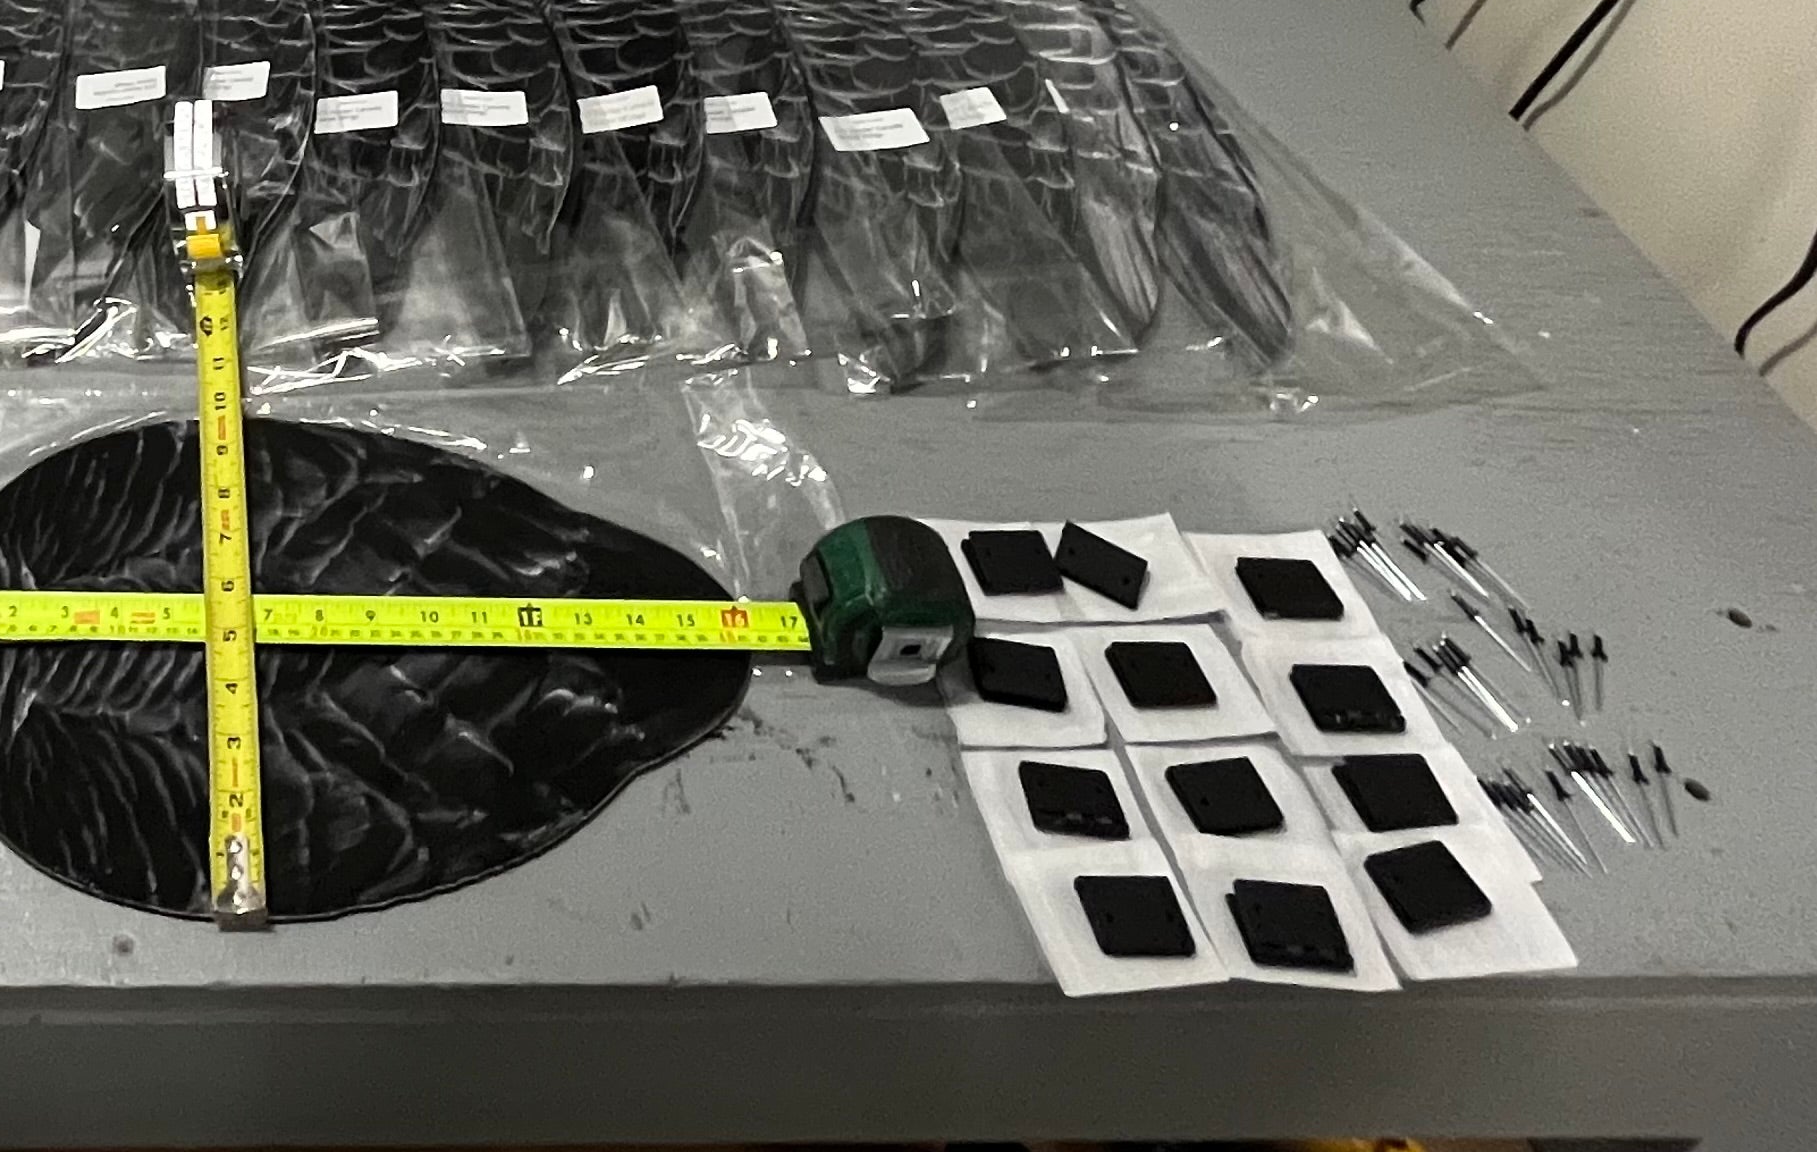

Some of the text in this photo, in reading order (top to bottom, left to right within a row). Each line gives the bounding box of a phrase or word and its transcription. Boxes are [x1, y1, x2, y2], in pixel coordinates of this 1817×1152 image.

[214, 392, 226, 410] 10
[216, 445, 229, 455] 9
[218, 489, 231, 499] 8
[219, 532, 232, 545] 7
[221, 580, 234, 592] 6
[9, 605, 18, 617] 2
[61, 605, 69, 618] 3
[110, 606, 119, 619] 4
[163, 607, 171, 620] 5
[264, 608, 273, 621] 7
[315, 609, 324, 622] 8
[365, 610, 376, 622] 9
[420, 611, 439, 623] 10
[471, 611, 488, 624] 11
[574, 612, 593, 625] 13
[626, 613, 645, 626] 14
[677, 613, 695, 627] 15
[781, 615, 798, 629] 17
[223, 630, 237, 642] 5
[225, 682, 239, 695] 4
[227, 737, 242, 750] 3
[229, 793, 244, 807] 2
